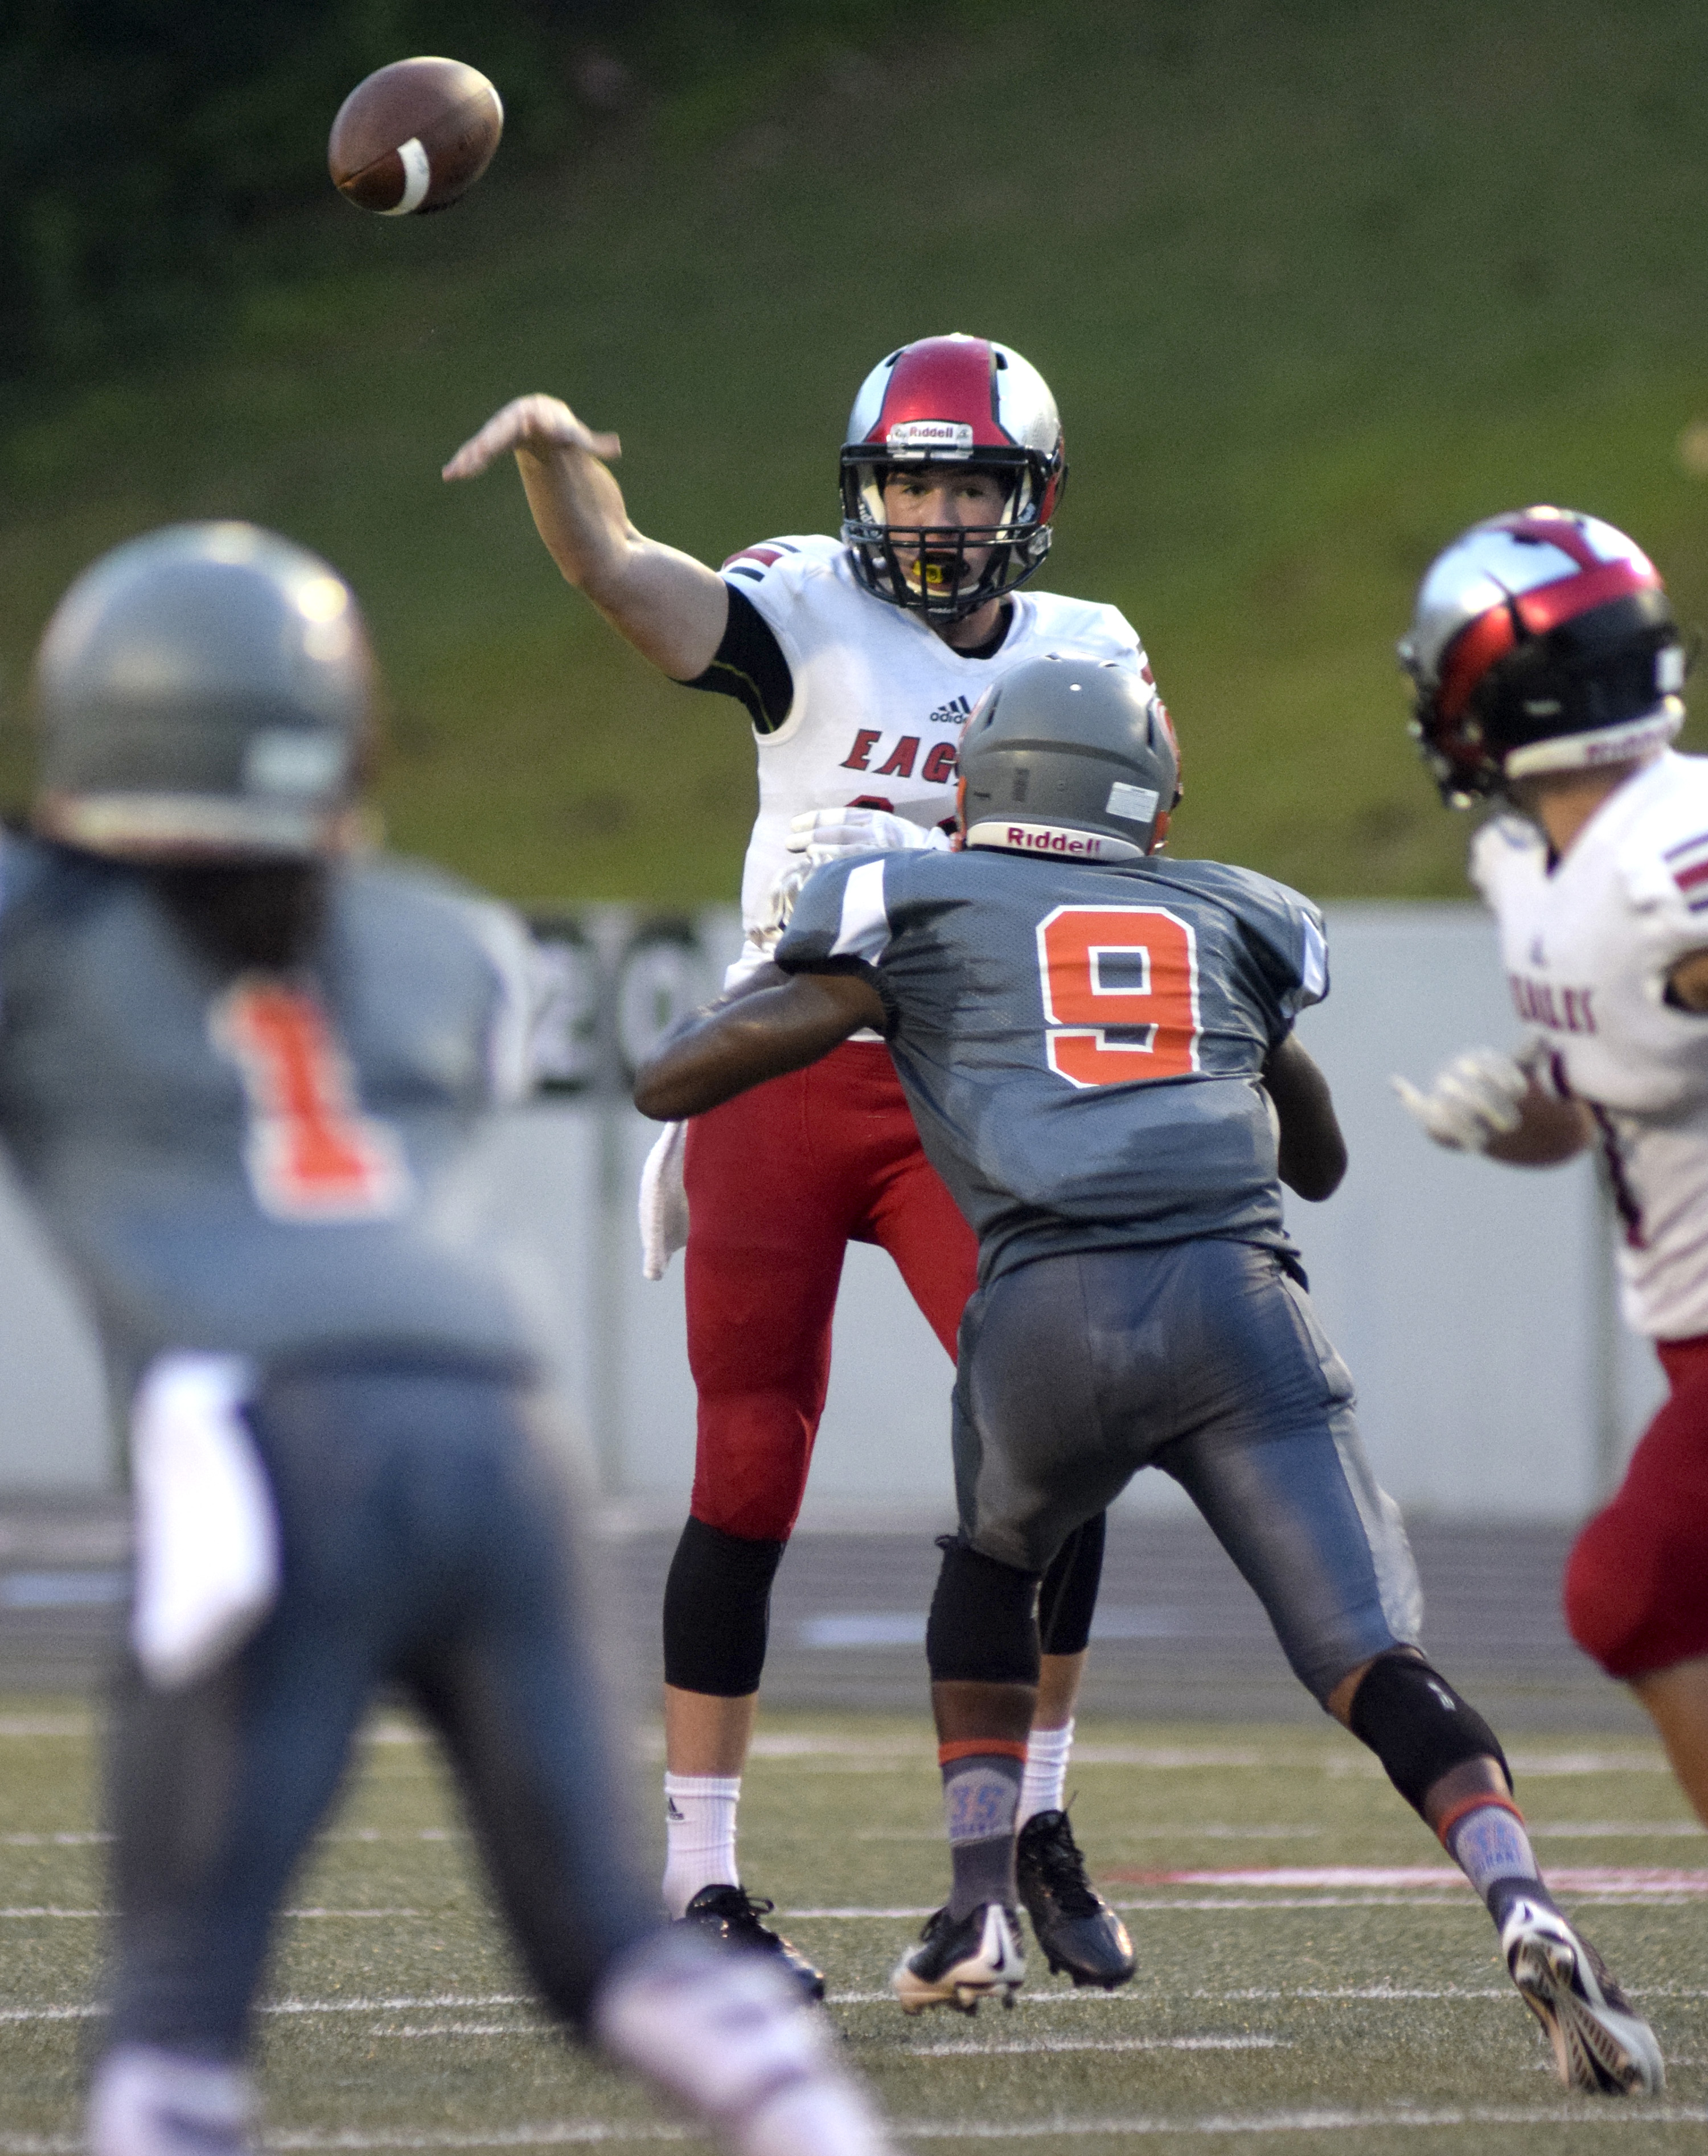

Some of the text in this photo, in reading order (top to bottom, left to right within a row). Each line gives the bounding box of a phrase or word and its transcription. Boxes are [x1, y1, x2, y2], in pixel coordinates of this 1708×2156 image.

[909, 425, 954, 438] Riddell
[930, 712, 967, 724] adid
[839, 728, 959, 786] EAG
[1007, 827, 1101, 854] Riddell
[1036, 904, 1204, 1089] 9
[214, 974, 407, 1219] 1
